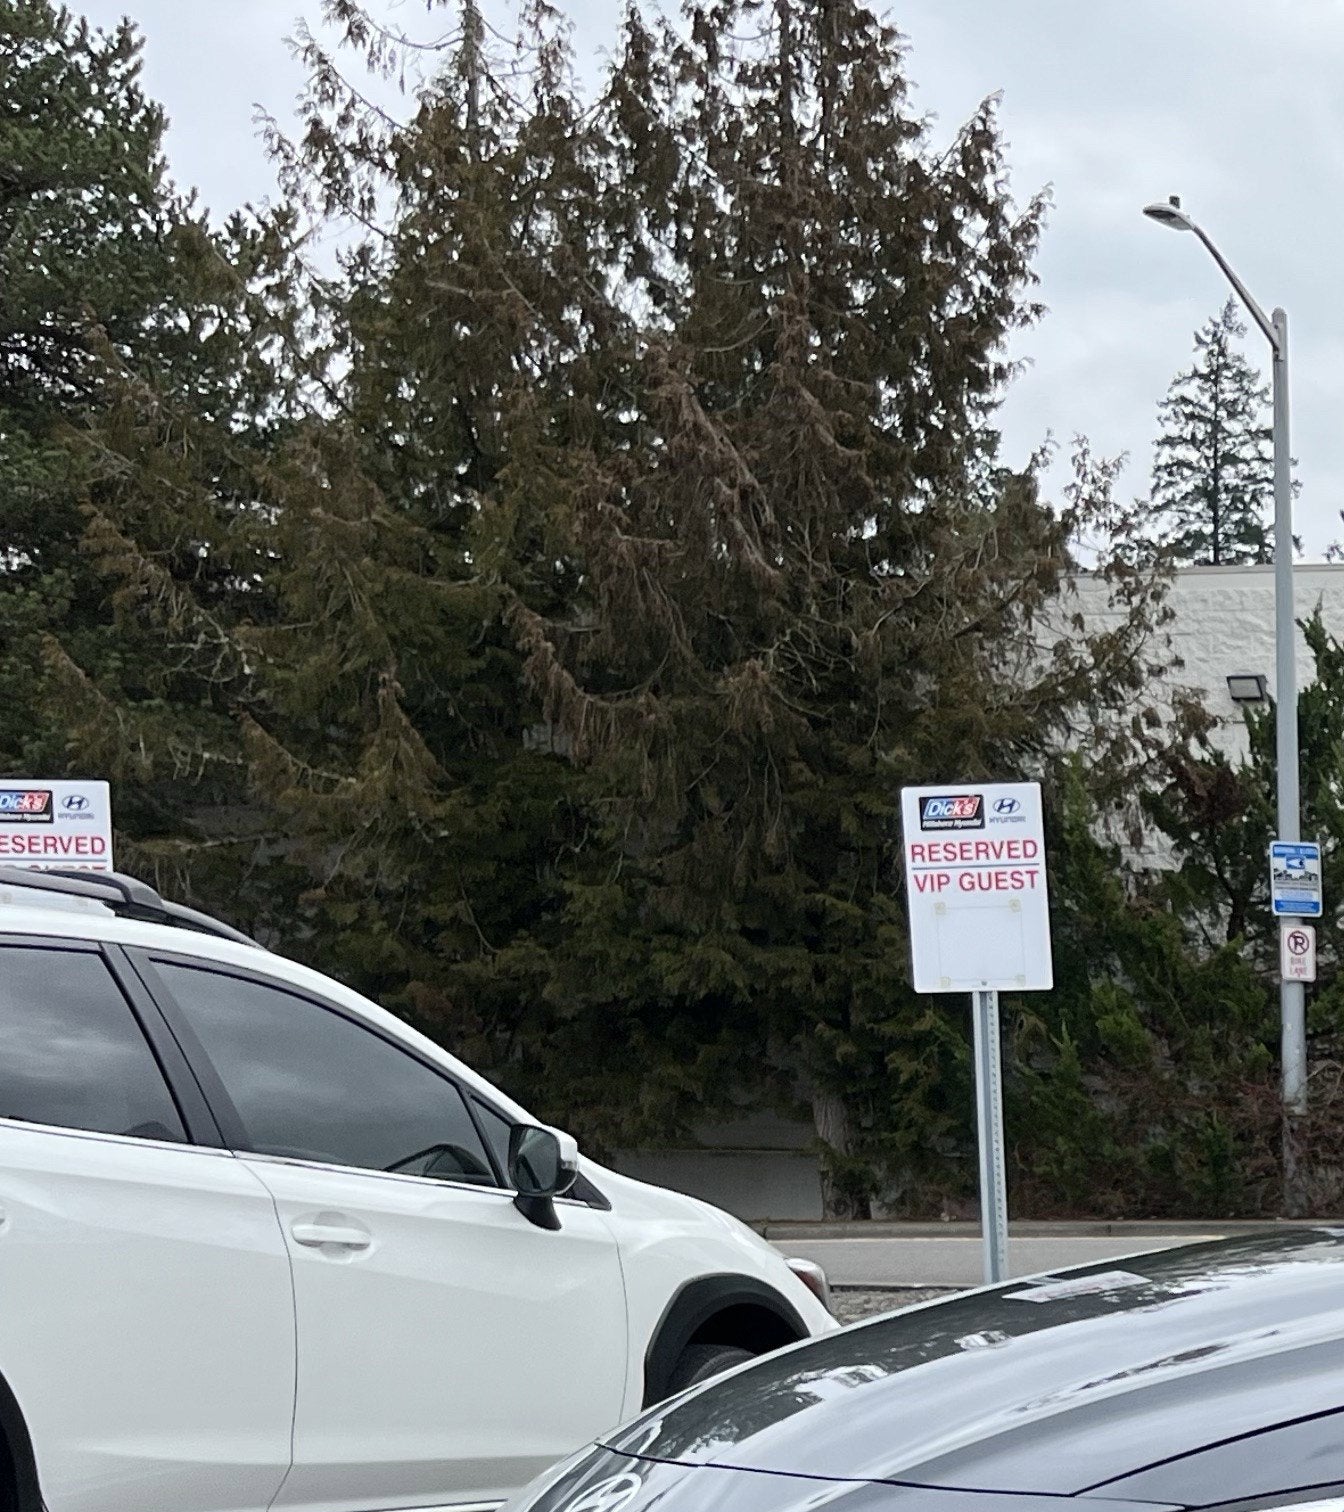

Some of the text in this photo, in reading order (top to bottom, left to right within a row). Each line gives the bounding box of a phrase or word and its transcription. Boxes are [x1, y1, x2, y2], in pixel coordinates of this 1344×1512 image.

[0, 835, 106, 855] ESERVED
[911, 839, 1038, 863] RESERVED
[914, 870, 1040, 893] VIP GUEST
